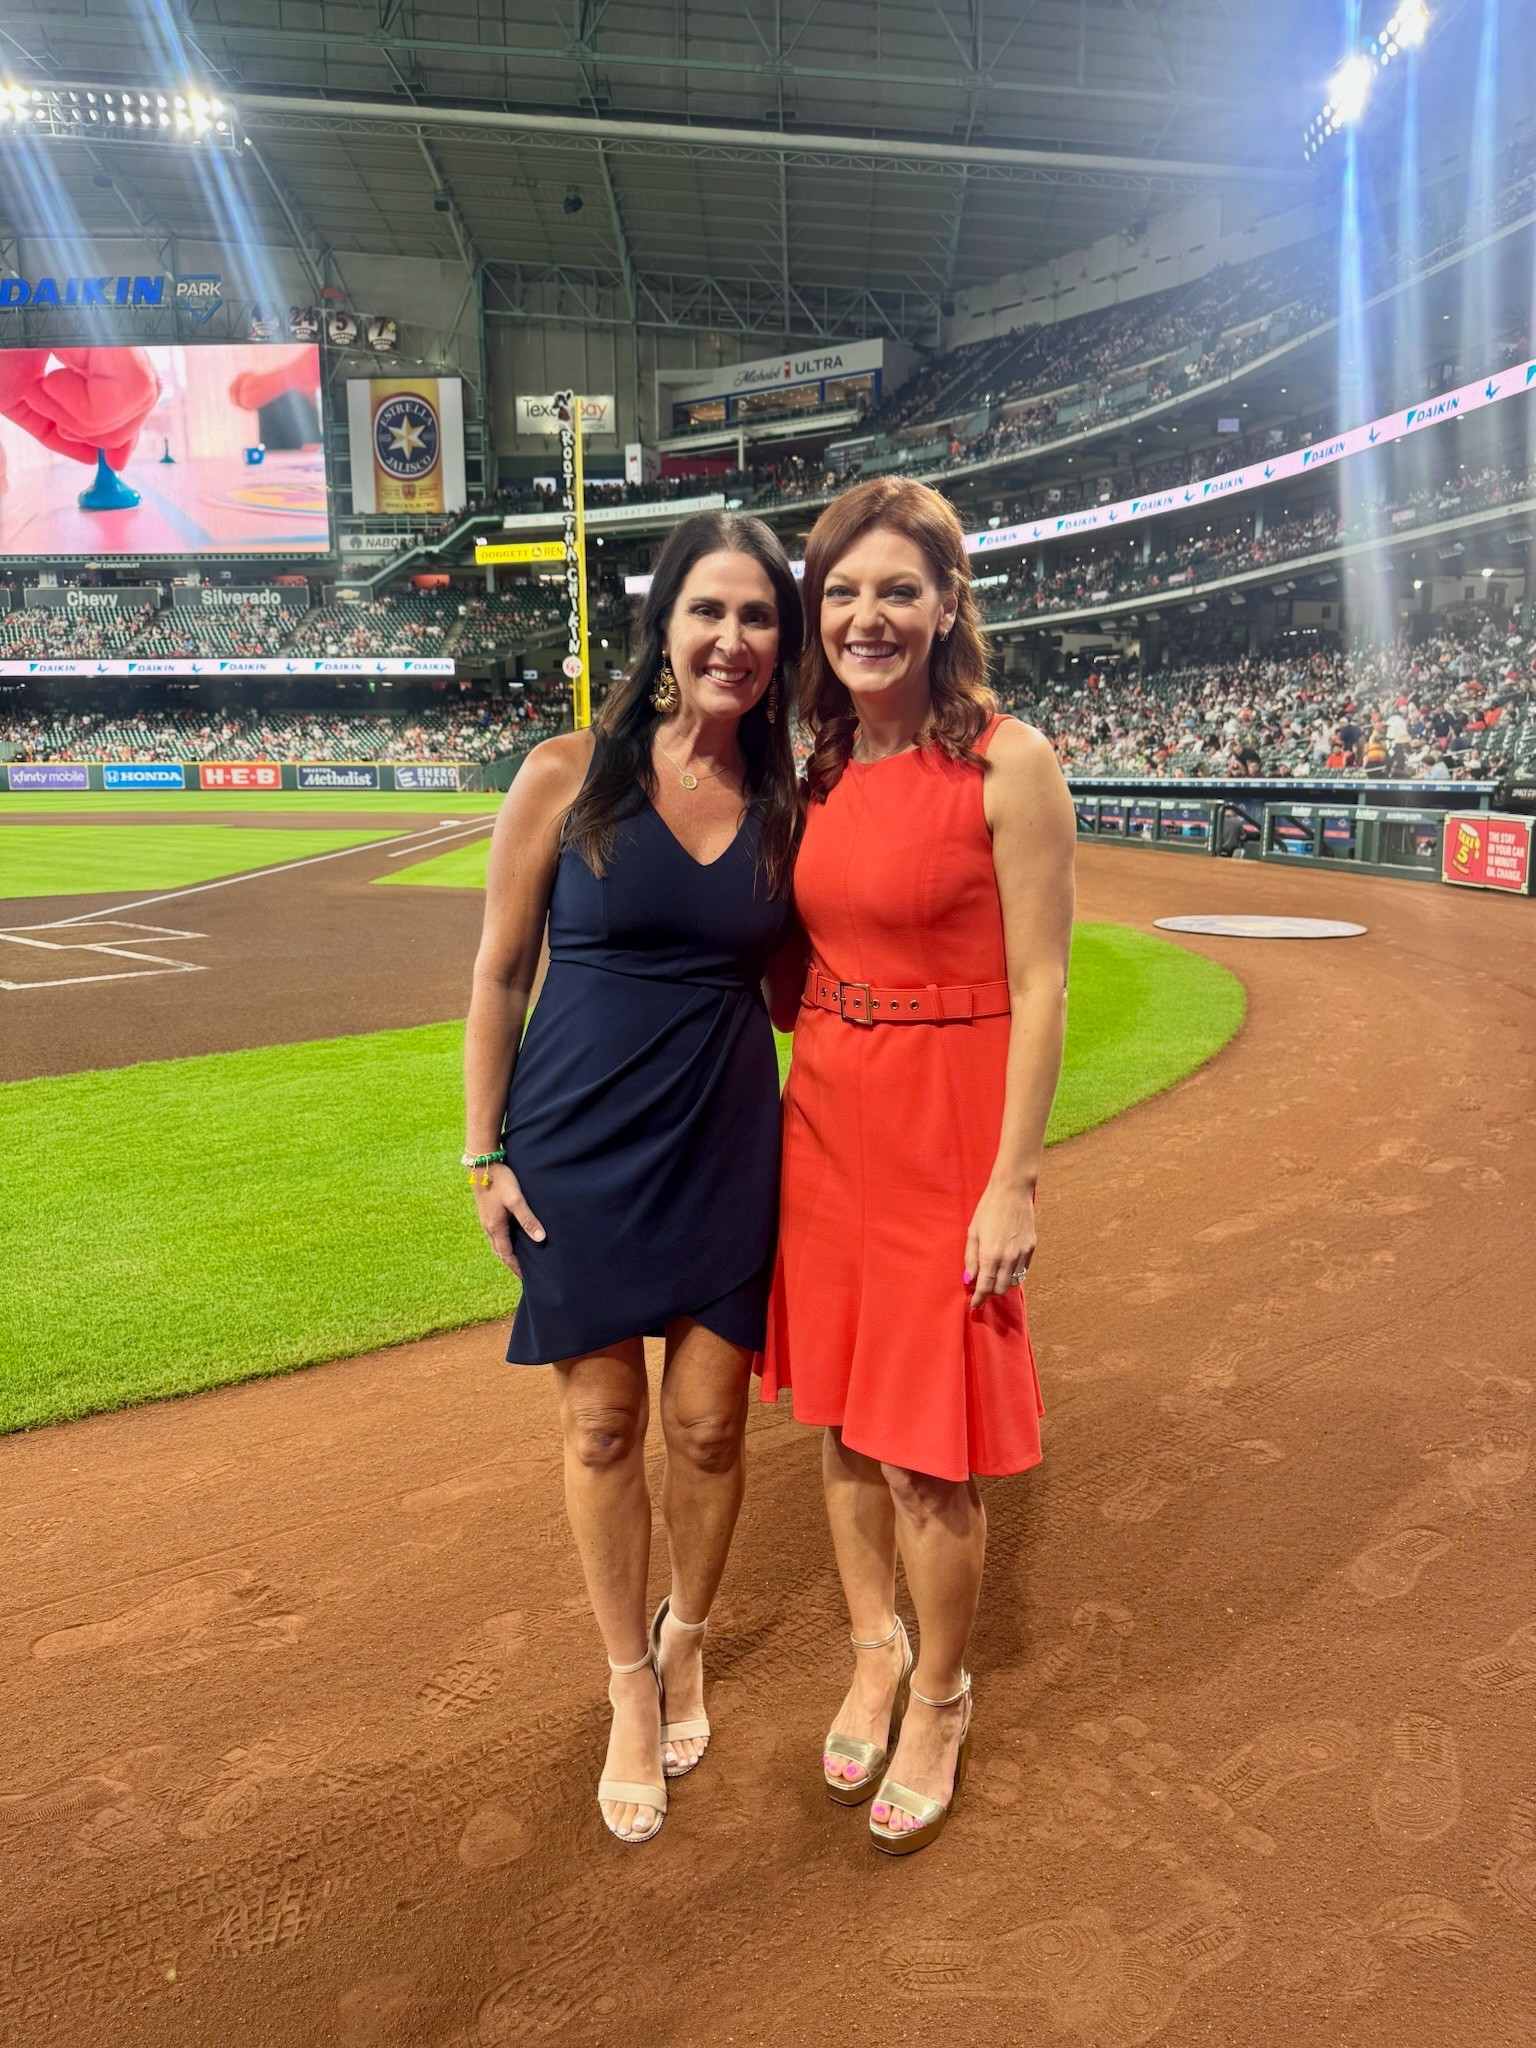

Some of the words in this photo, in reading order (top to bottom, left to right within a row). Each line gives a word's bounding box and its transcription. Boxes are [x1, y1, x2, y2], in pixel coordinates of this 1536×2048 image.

[0, 276, 165, 307] DAIKIN
[177, 283, 221, 296] PARK
[795, 356, 842, 375] ULTRA
[379, 402, 434, 427] ESTRELLA
[523, 400, 558, 418] Texa
[1417, 398, 1459, 422] DAIKIN
[1312, 443, 1345, 462] DAIKIN
[385, 455, 431, 474] JALISCO
[561, 430, 574, 490] ROOT
[1212, 477, 1244, 493] DAIKIN
[1140, 497, 1173, 511] DAIKIN
[1065, 516, 1098, 530] DAIKIN
[481, 551, 529, 559] DOGGETT
[66, 591, 119, 609] Chevy
[201, 589, 282, 606] Silverado
[566, 567, 582, 656] CHIKIN
[39, 664, 77, 672] DAIKIN
[138, 664, 175, 672] DAIKIN
[230, 663, 268, 671] DAIKIN
[323, 663, 361, 671] DAIKIN
[413, 663, 452, 671] DAIKIN
[12, 771, 47, 784] xfinity
[49, 771, 85, 782] mobile
[120, 772, 182, 782] HONDA
[417, 768, 456, 777] ENERG
[418, 778, 456, 787] TRANS
[1457, 828, 1476, 849] TAKE
[1488, 831, 1501, 842] THE
[1501, 832, 1517, 844] STAY
[1456, 845, 1470, 864] 5
[1487, 843, 1496, 853] IN
[1496, 844, 1512, 856] YOUR
[1512, 846, 1525, 857] CAR
[1495, 855, 1518, 869] MINUTE
[1486, 866, 1496, 877] OIL
